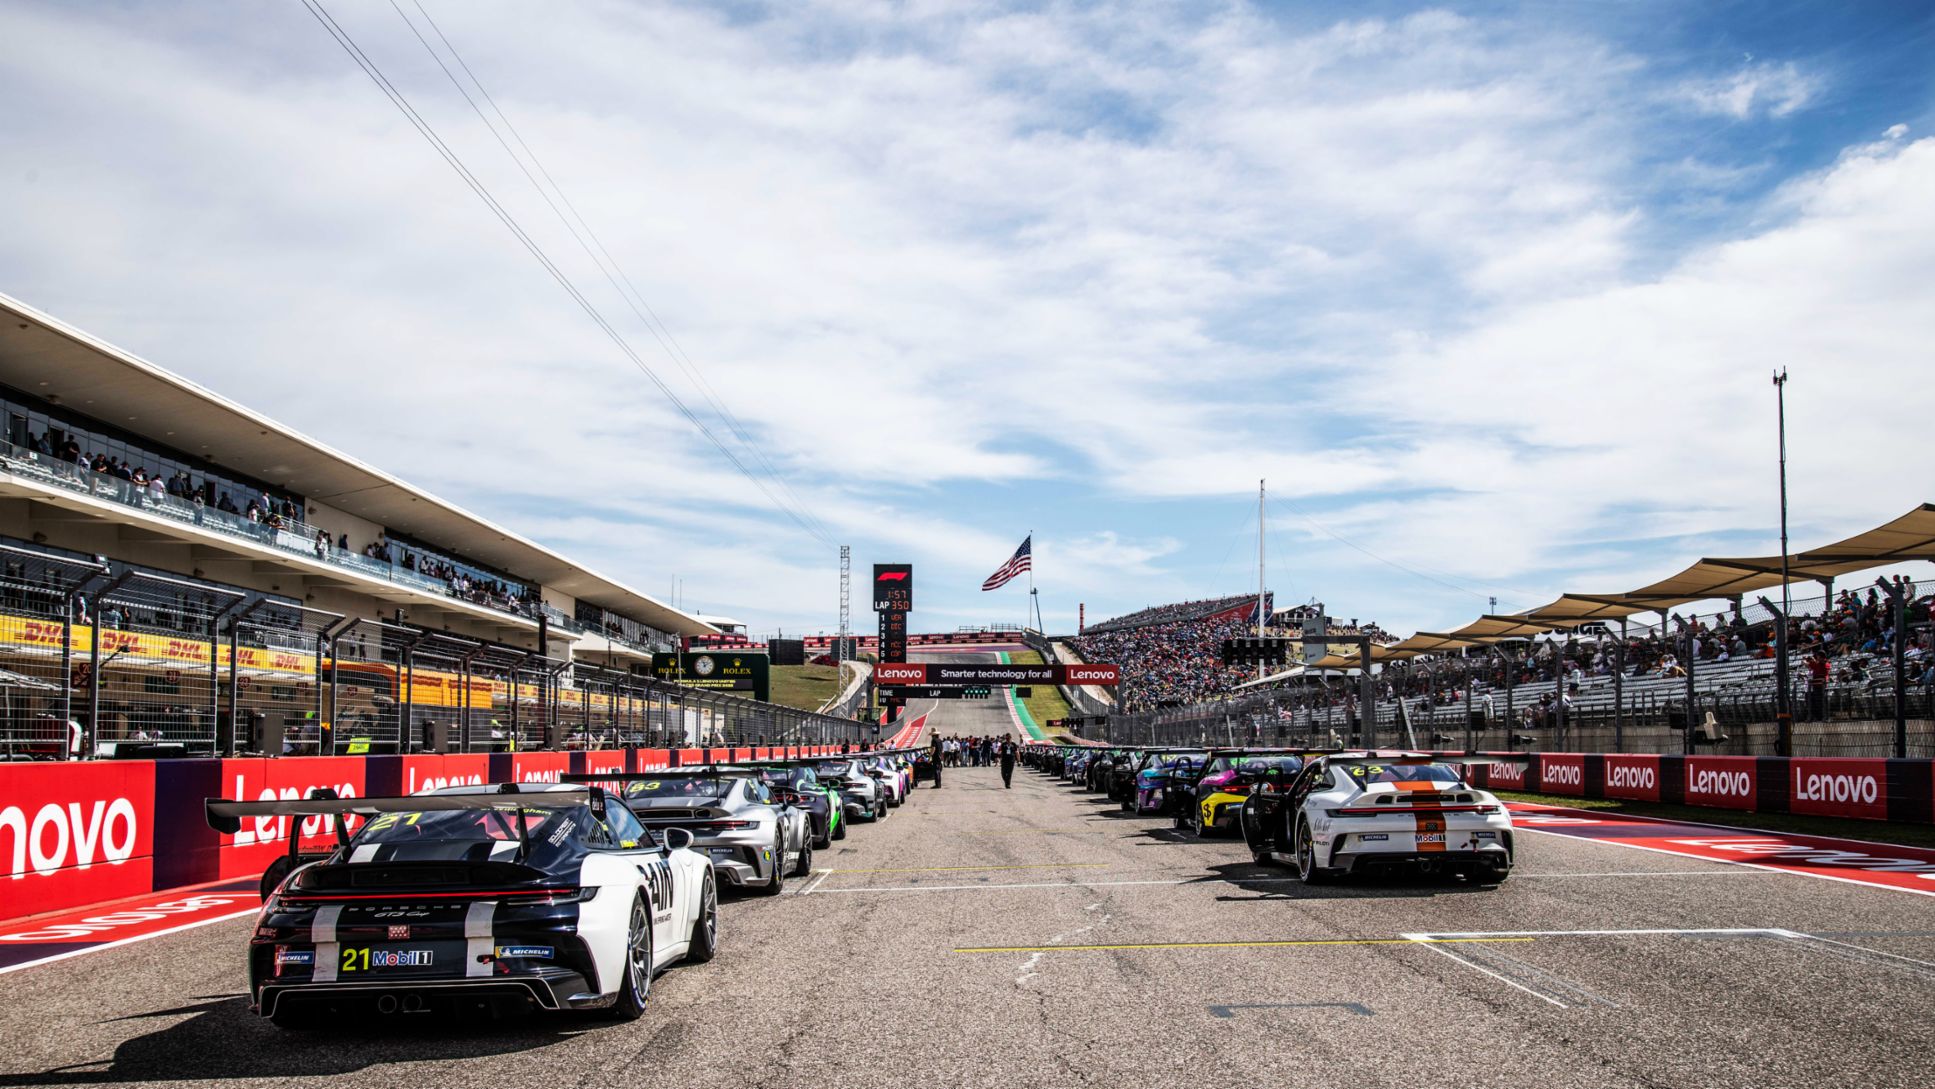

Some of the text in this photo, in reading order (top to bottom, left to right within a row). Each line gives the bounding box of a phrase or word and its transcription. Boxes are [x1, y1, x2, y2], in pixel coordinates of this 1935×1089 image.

[875, 601, 890, 609] LAP
[24, 622, 63, 643] DH
[878, 668, 922, 678] Lenovo
[941, 669, 1052, 681] Smarter technology for all
[1070, 669, 1115, 679] Lenovo
[880, 689, 893, 697] TIME
[1490, 762, 1521, 780] Lenovo
[1542, 759, 1580, 785] Lenovo
[1607, 760, 1655, 789] Lenovo
[1689, 764, 1750, 796] Lenovo
[1796, 766, 1877, 804] Lenovo
[368, 813, 422, 831] 21
[1415, 834, 1439, 843] Mobil
[374, 910, 431, 918] GT3 Cup
[342, 948, 370, 972] 21
[373, 951, 416, 967] Mobil
